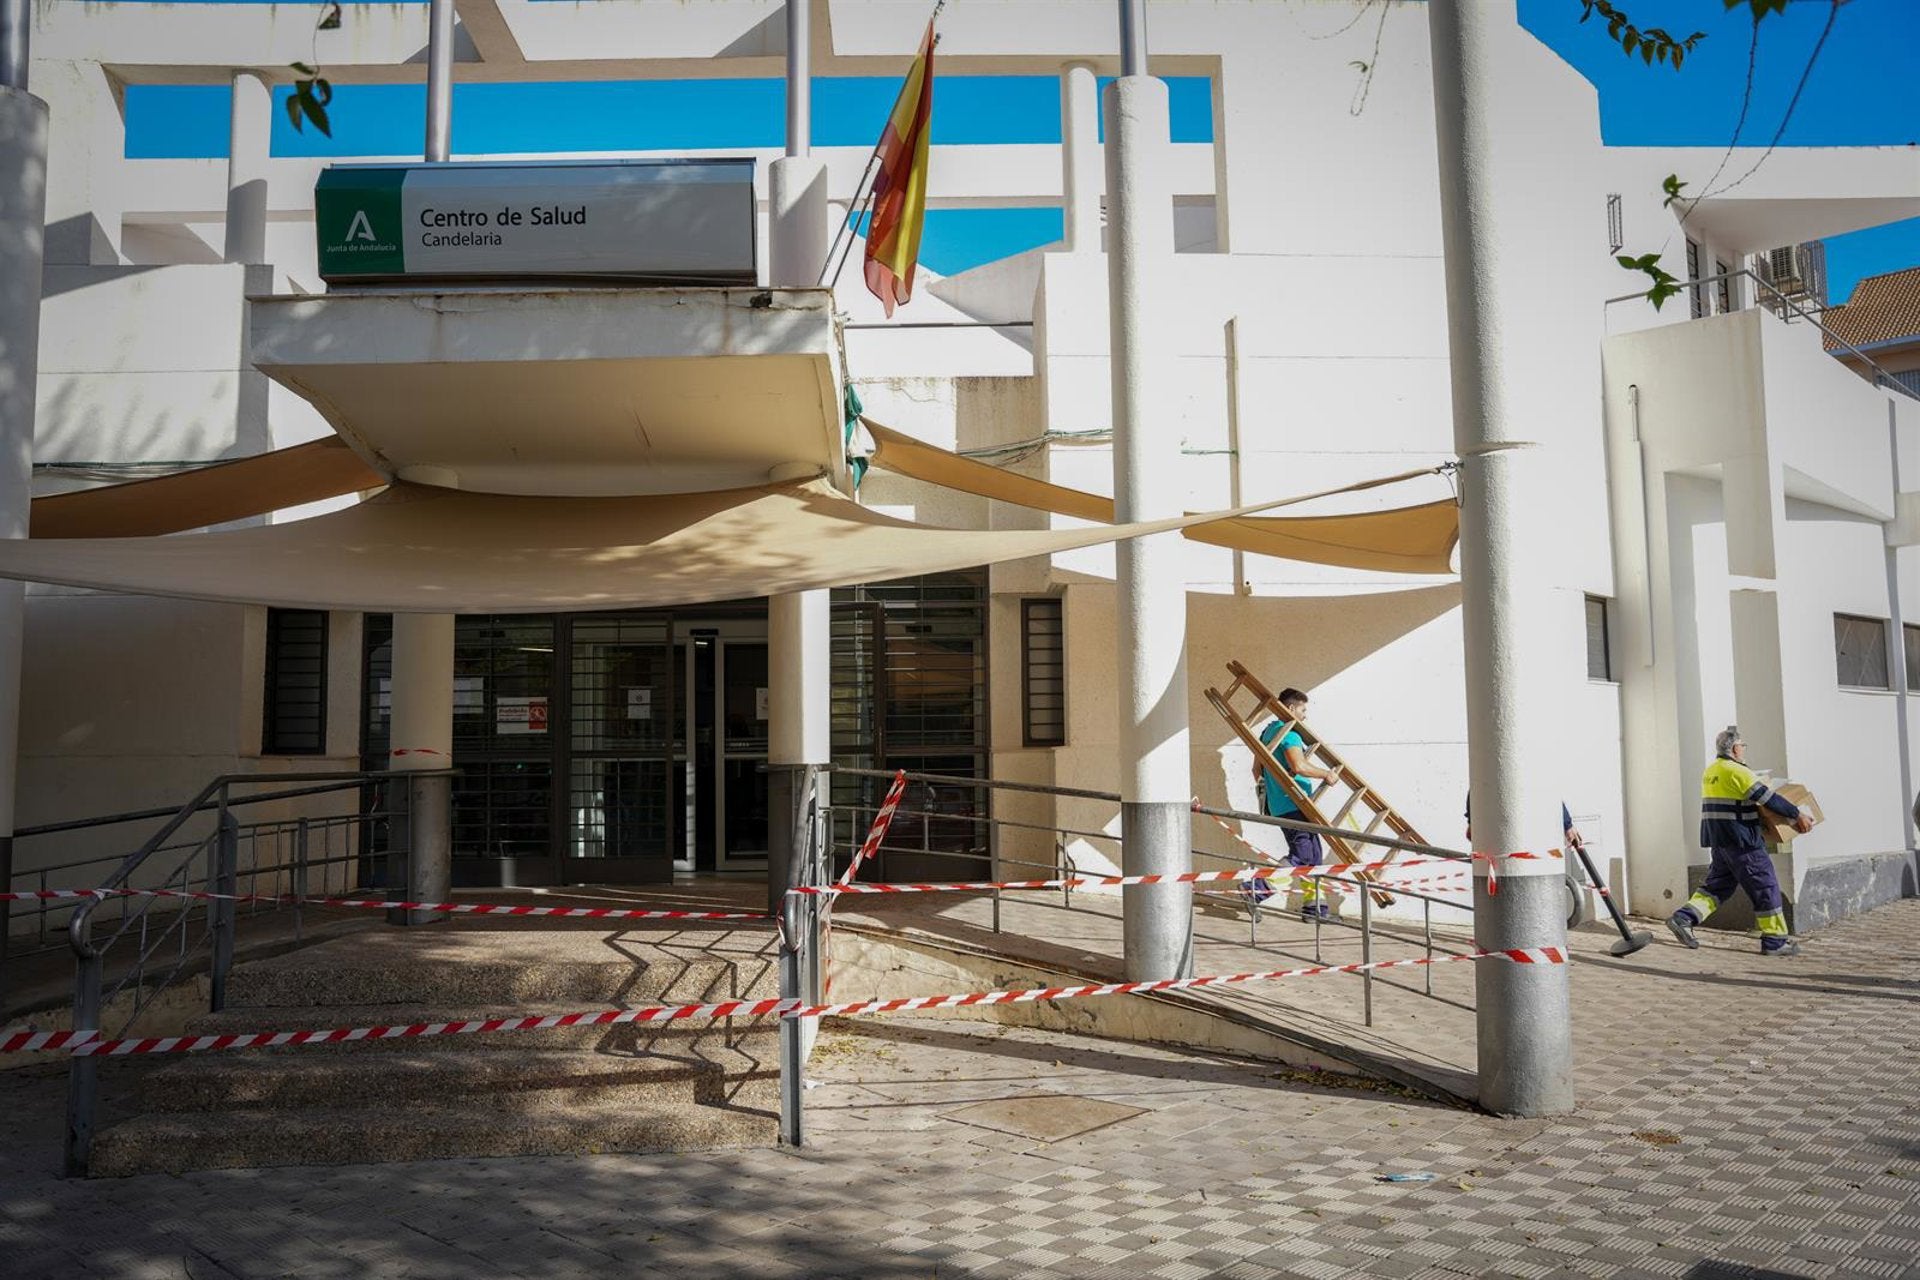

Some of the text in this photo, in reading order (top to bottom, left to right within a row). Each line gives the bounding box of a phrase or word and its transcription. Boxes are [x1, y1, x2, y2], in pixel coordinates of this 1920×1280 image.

[420, 205, 586, 227] Centro de Salud
[421, 231, 502, 247] Candelaria
[326, 243, 348, 253] Junta
[348, 243, 359, 252] de
